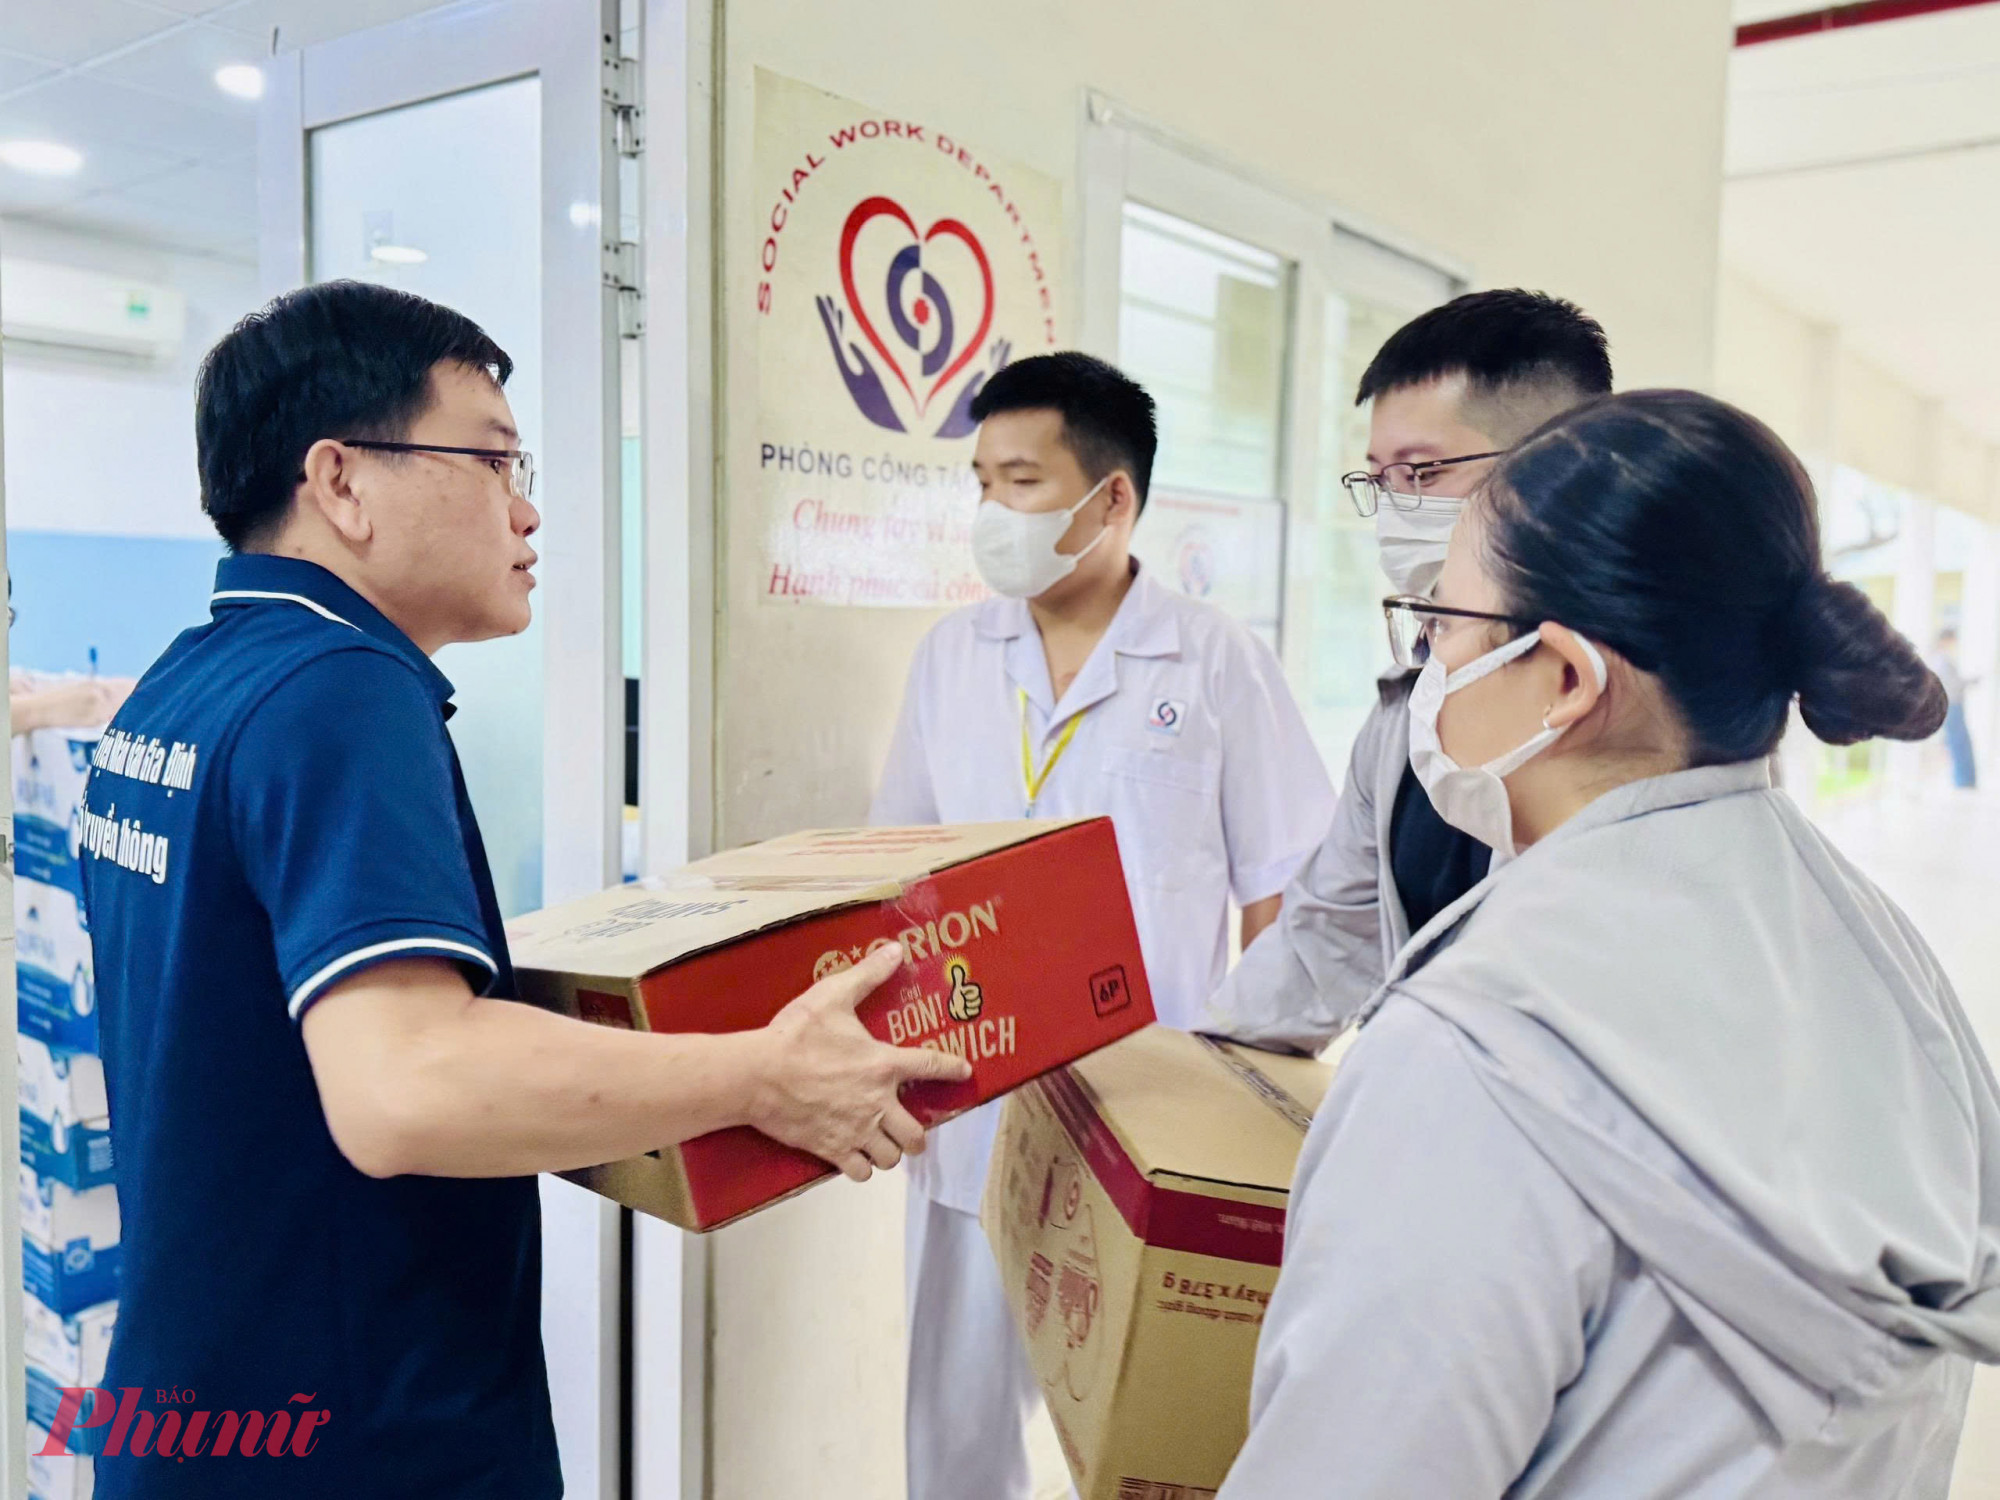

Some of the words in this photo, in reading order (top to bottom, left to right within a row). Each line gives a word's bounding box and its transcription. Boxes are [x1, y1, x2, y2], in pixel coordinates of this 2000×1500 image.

[757, 153, 825, 315] SOCIAL
[829, 119, 925, 150] WORK
[936, 134, 1055, 346] DEPARTMEN
[760, 441, 852, 479] PHÒNG
[862, 453, 928, 488] CÔNG
[793, 498, 876, 544] Chung
[161, 741, 197, 798] Định
[117, 818, 169, 884] thông
[886, 991, 946, 1045] BON!
